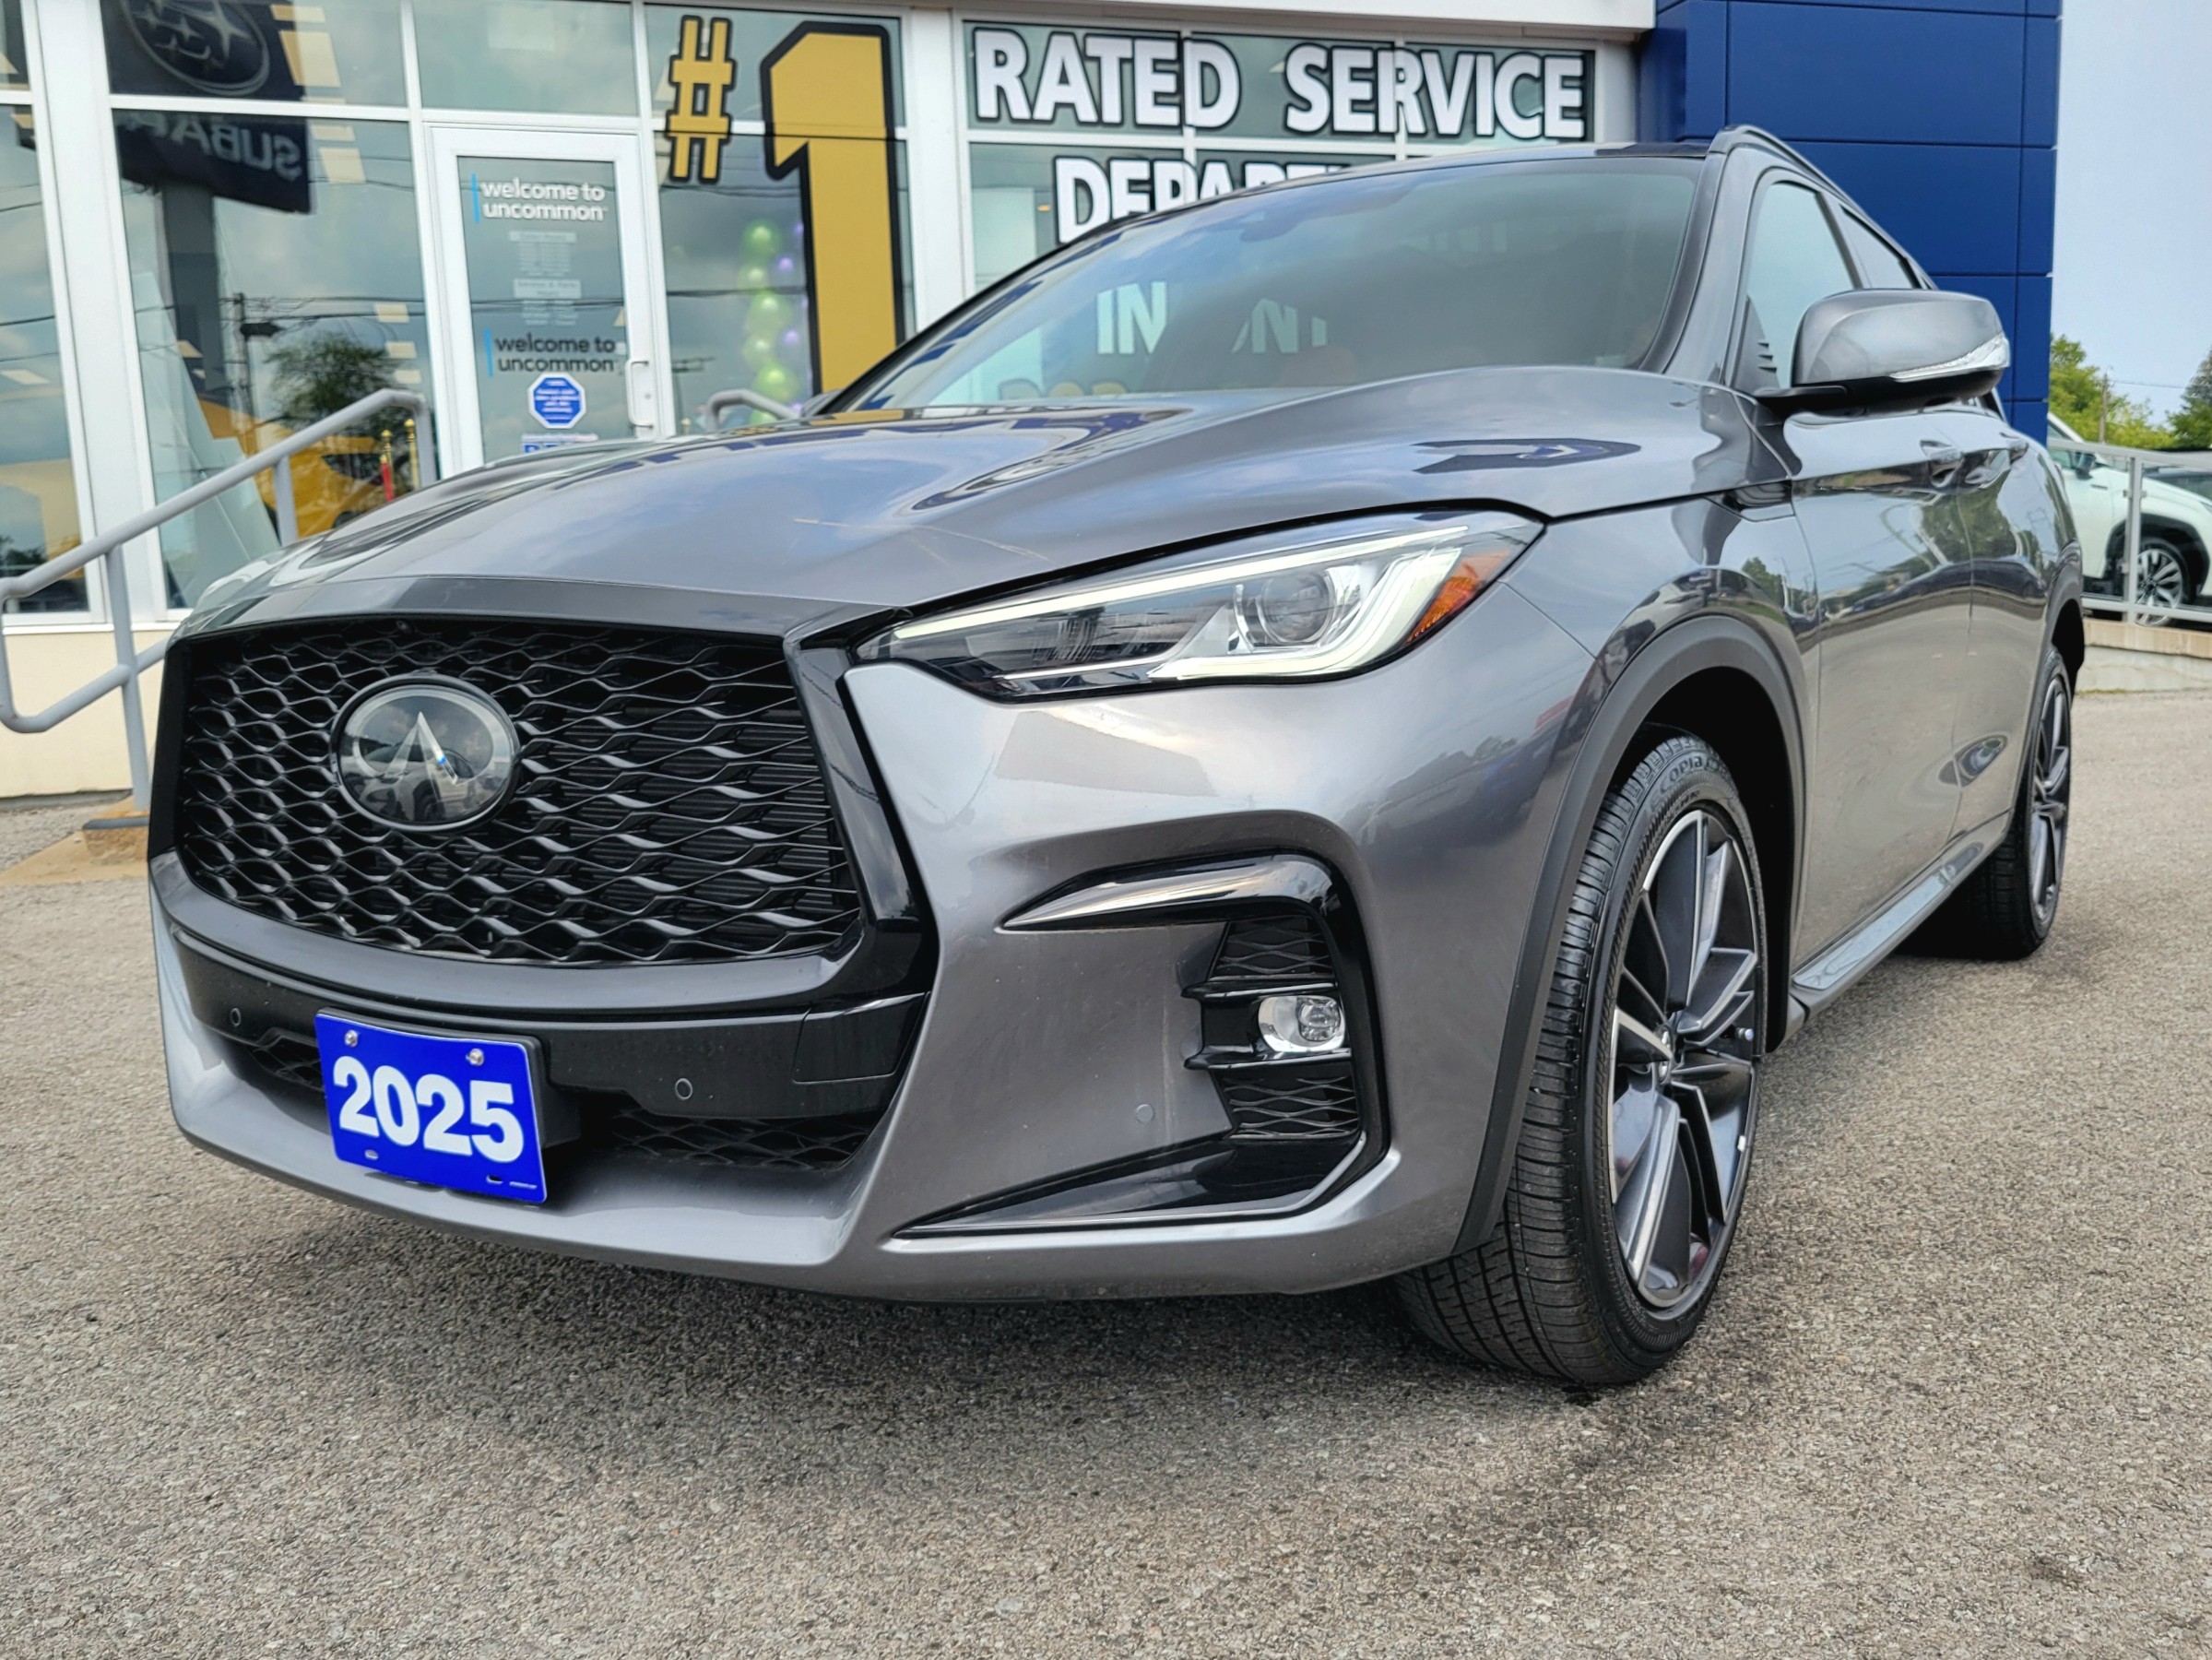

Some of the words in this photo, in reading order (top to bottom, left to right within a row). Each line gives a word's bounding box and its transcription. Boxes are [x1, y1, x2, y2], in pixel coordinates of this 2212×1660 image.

[973, 29, 1241, 130] RATED
[1285, 43, 1587, 140] SERVICE
[480, 177, 579, 201] welcome
[581, 182, 606, 202] to
[482, 202, 605, 221] uncommon
[494, 332, 590, 352] welcome
[594, 336, 616, 353] to
[498, 358, 615, 372] uncommon
[333, 1055, 524, 1163] 2025
